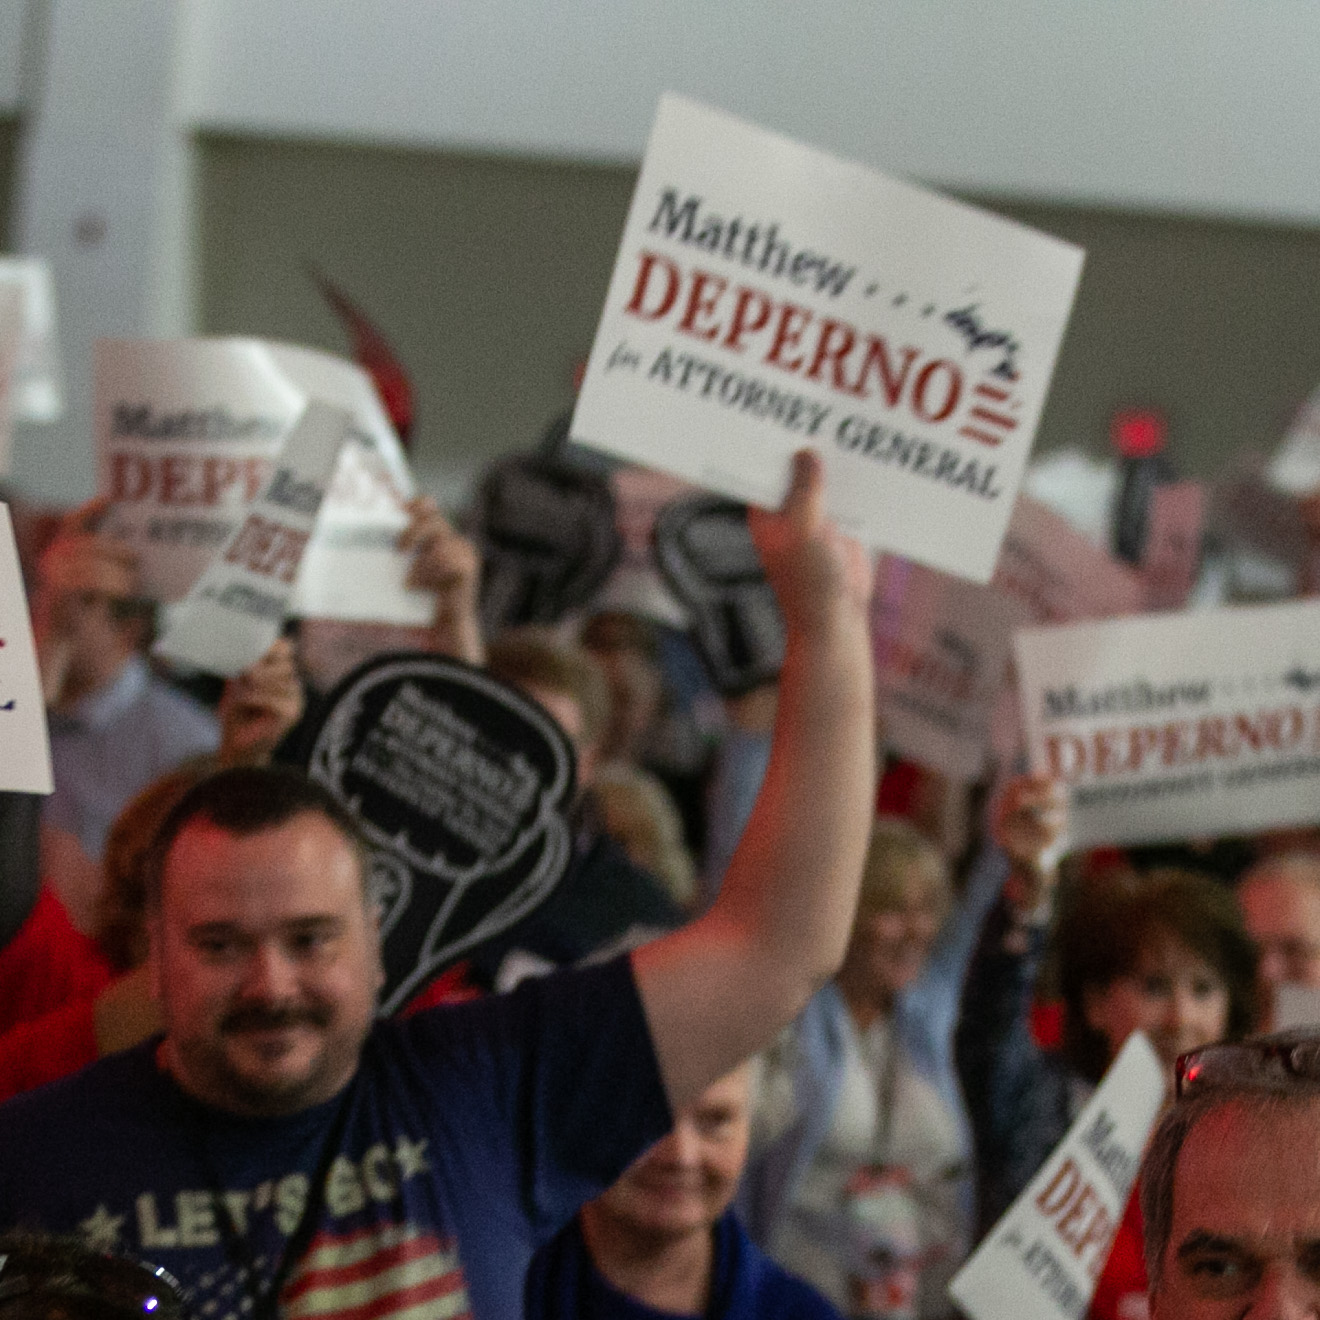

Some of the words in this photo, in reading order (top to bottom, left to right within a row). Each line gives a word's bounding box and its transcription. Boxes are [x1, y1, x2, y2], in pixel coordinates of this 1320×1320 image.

[647, 185, 856, 299] Matthew
[624, 249, 965, 424] DEPERNO
[648, 345, 834, 438] ATTORNEY
[836, 411, 1003, 501] GENERAL
[1044, 706, 1306, 780] DEPERNO
[135, 1171, 311, 1249] LET'S
